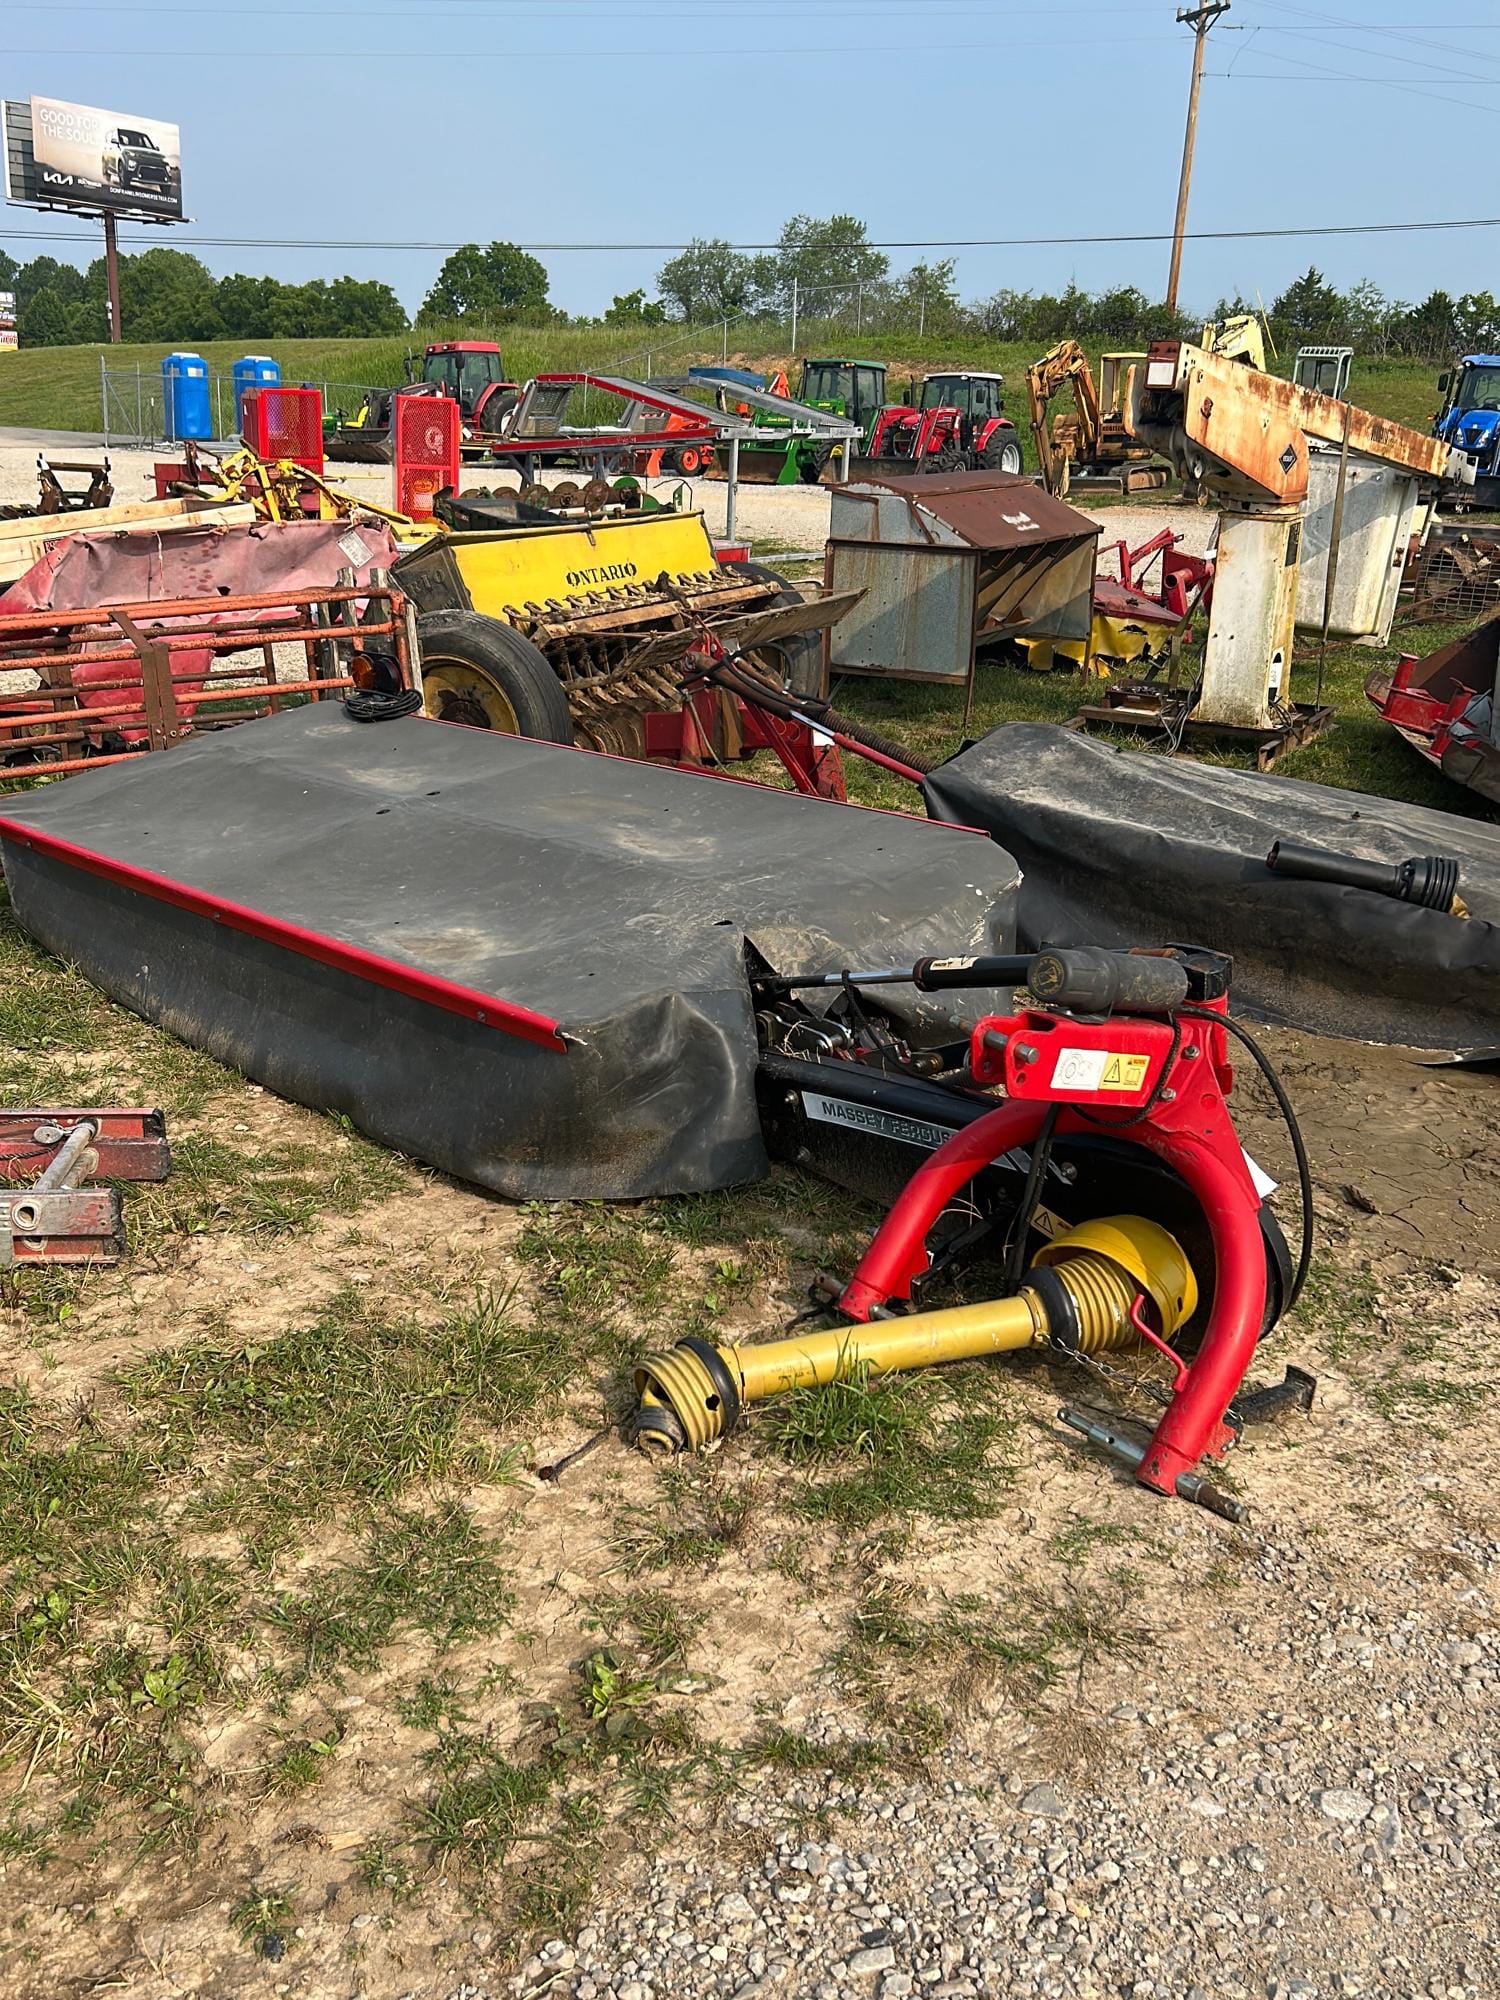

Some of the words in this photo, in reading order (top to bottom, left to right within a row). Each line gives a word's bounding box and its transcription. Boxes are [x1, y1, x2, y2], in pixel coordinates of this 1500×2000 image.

[40, 108, 74, 127] GOOD
[77, 115, 99, 131] FOR
[40, 122, 65, 140] THE
[66, 127, 99, 145] SOUL
[566, 562, 637, 587] ONTARIO
[822, 1101, 885, 1130] MASSEY
[890, 1120, 957, 1146] FERGUS
